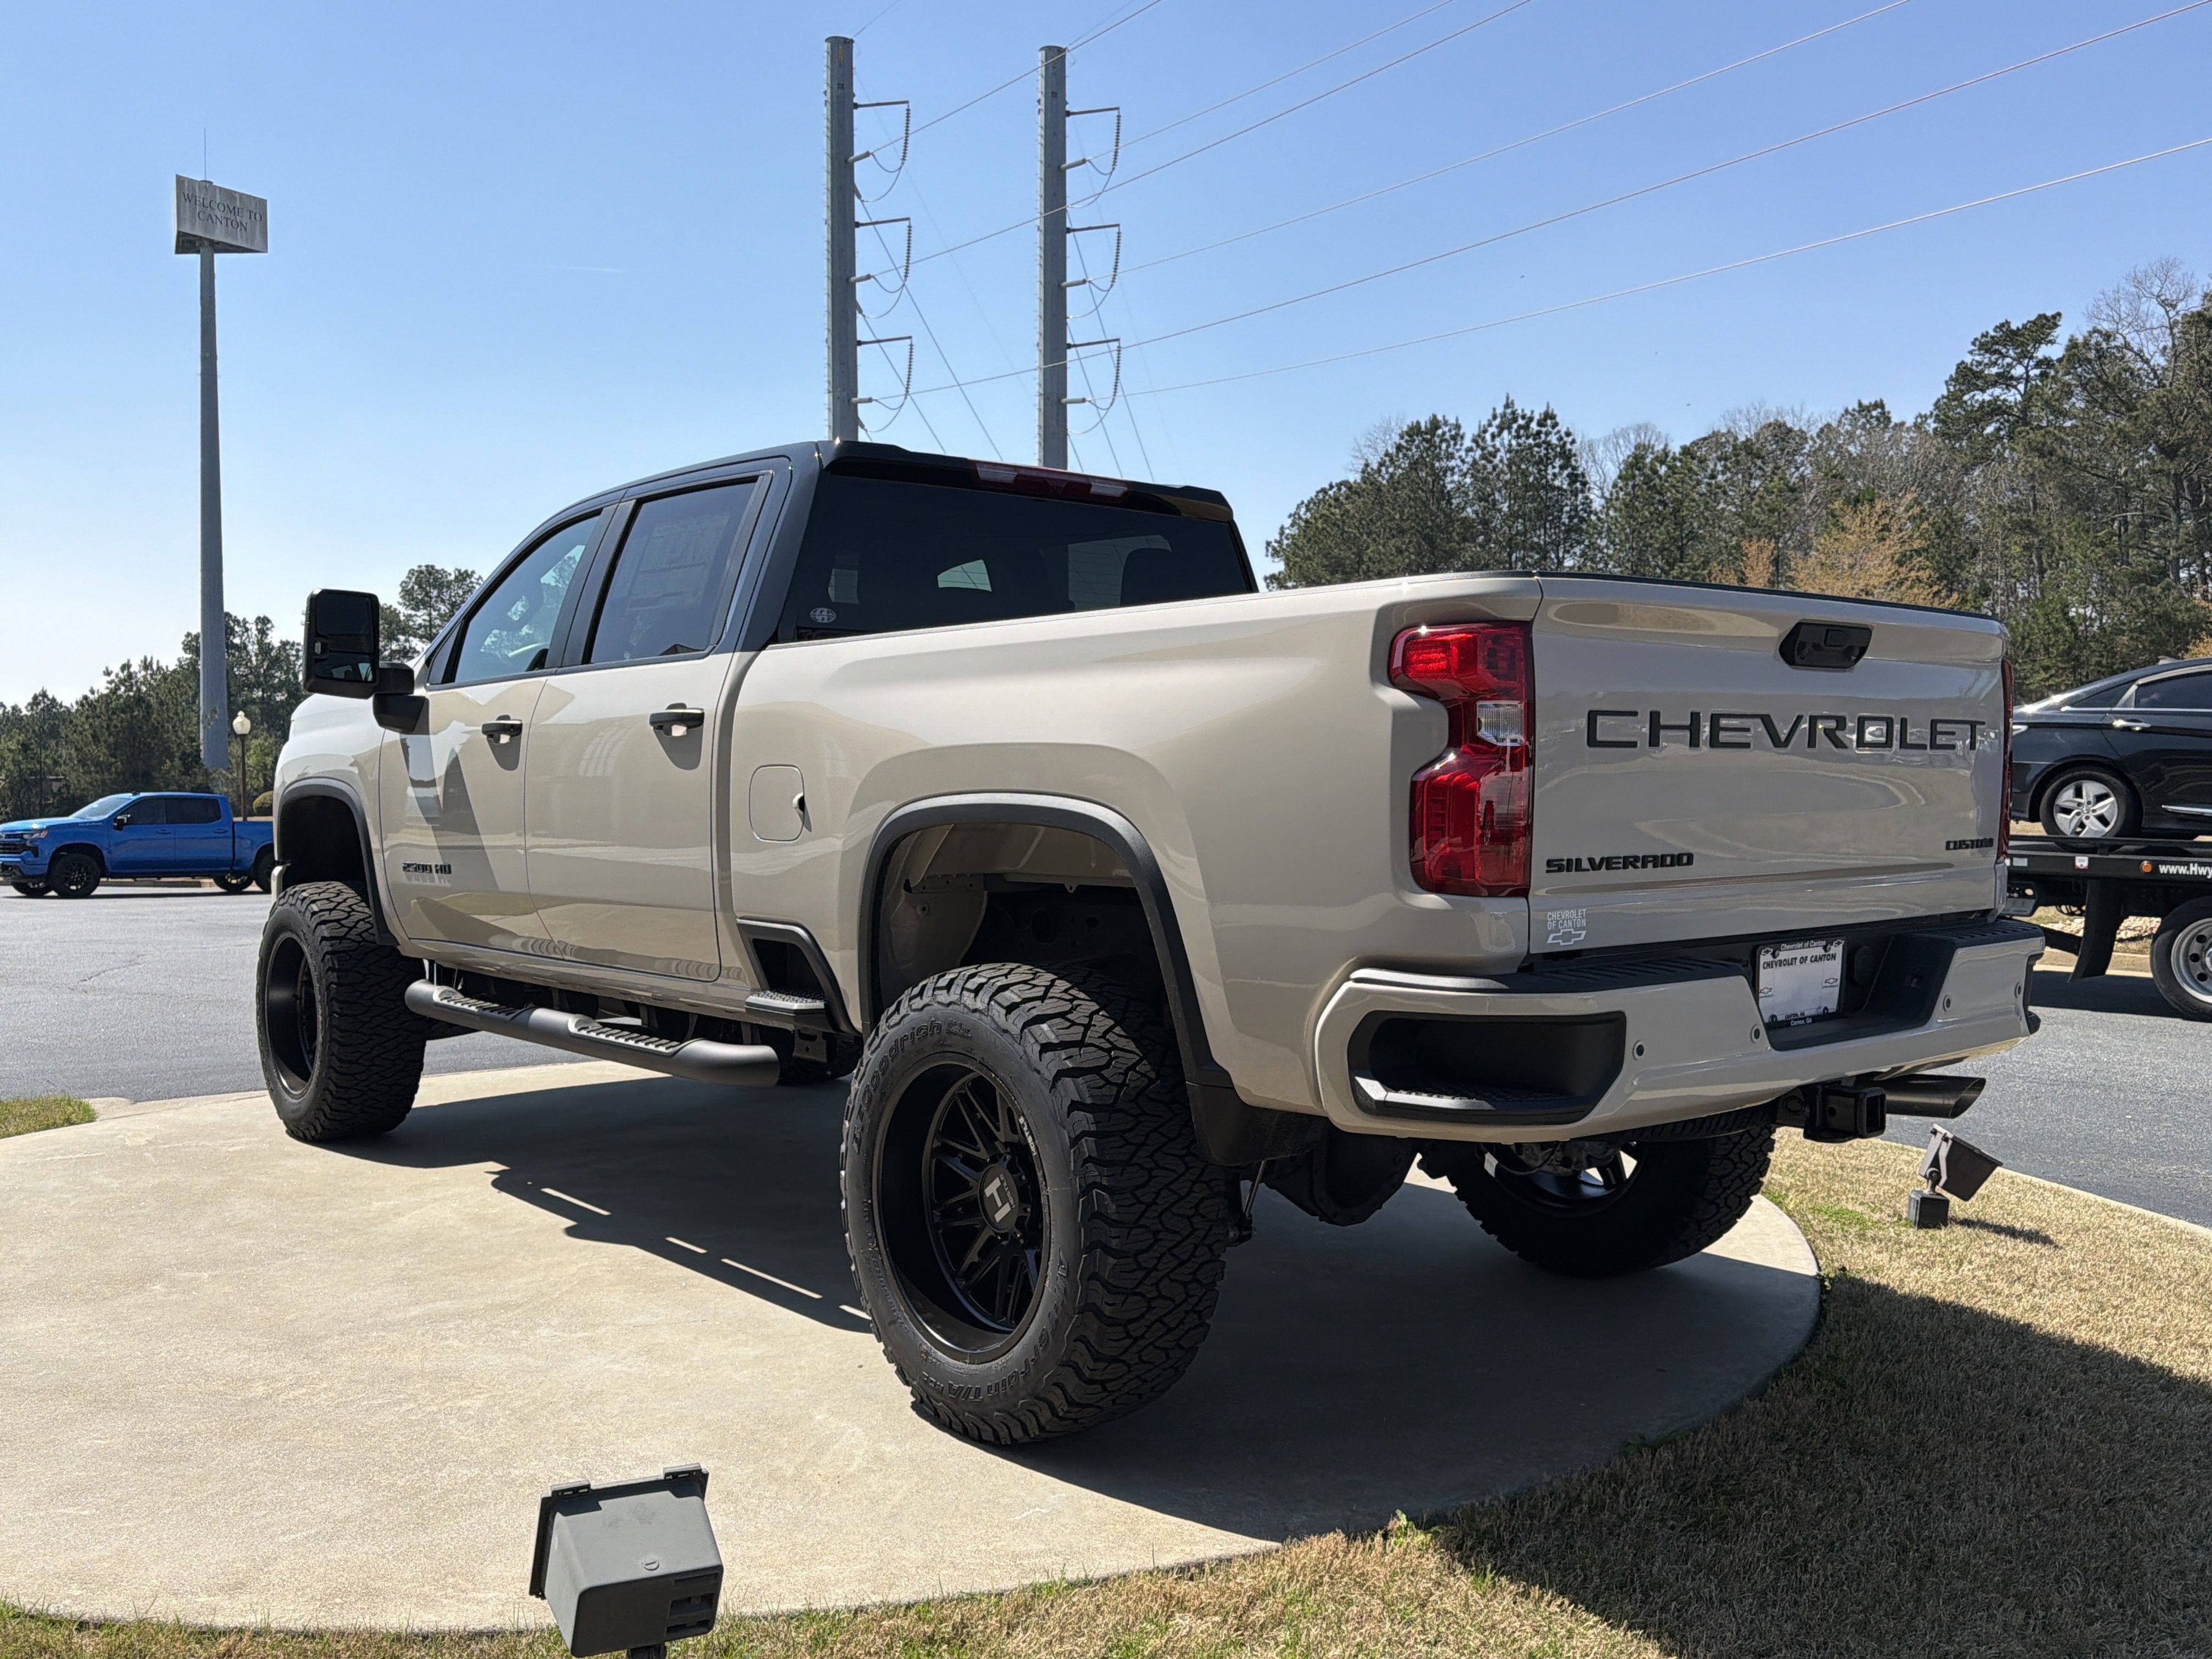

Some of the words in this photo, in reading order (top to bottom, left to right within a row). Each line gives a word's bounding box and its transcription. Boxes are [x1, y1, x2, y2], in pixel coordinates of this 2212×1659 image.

[183, 193, 244, 217] WELCOME
[247, 210, 262, 222] TO
[198, 211, 247, 232] CANTON
[1587, 710, 1985, 751] CHEVROLET
[1545, 852, 1694, 873] SILVERADO
[1547, 909, 1587, 921] CHEVROLET
[1548, 921, 1556, 930] OF
[1558, 918, 1586, 929] CANTON
[1763, 957, 1797, 969] CHEVROLET
[1799, 956, 1808, 964] OF
[1810, 953, 1837, 963] CANTON
